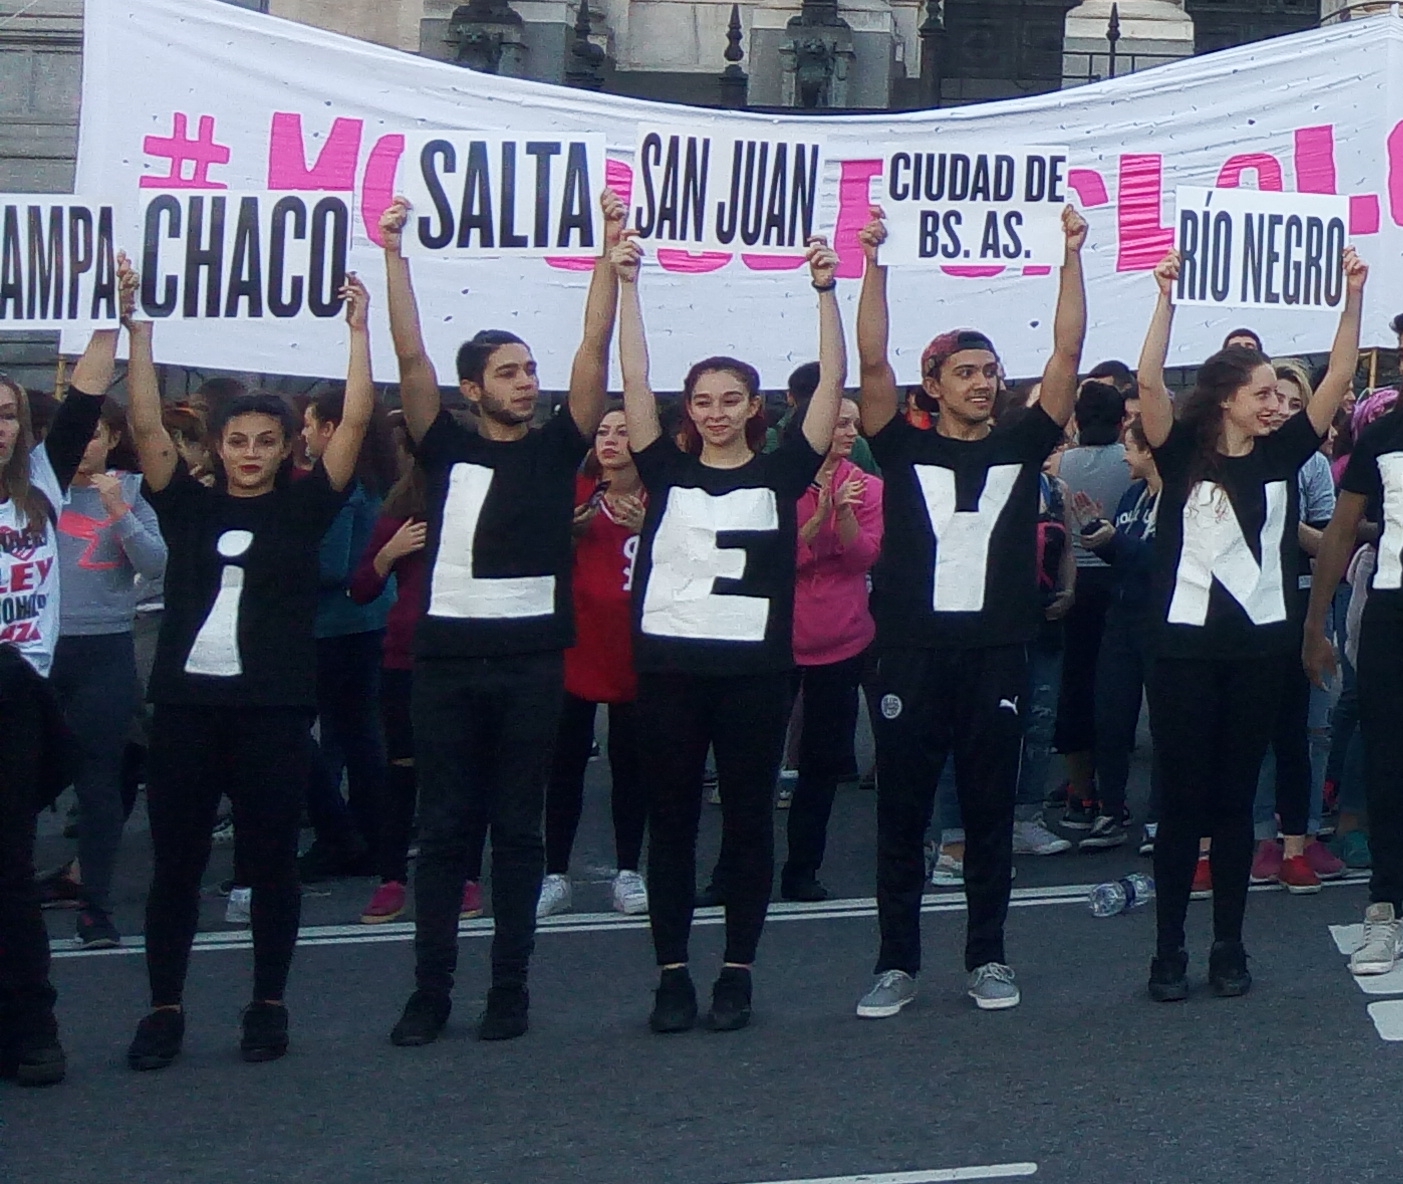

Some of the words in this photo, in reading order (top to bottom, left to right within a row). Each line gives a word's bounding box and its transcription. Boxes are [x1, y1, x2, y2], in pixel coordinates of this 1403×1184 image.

[417, 138, 595, 250] SALTA
[636, 132, 711, 242] SAN
[715, 139, 819, 247] JUAN
[888, 152, 1014, 203] CIUDAD
[1024, 154, 1067, 204] DE
[918, 209, 971, 260] BS.
[979, 210, 1031, 260] AS.
[0, 204, 117, 320] AMPA
[140, 195, 349, 318] CHACO
[1177, 190, 1231, 303] RÍO
[1242, 212, 1344, 307] NEGRO
[427, 461, 555, 618] L
[641, 486, 779, 641] E
[913, 463, 1023, 612] Y
[1166, 479, 1288, 627] N
